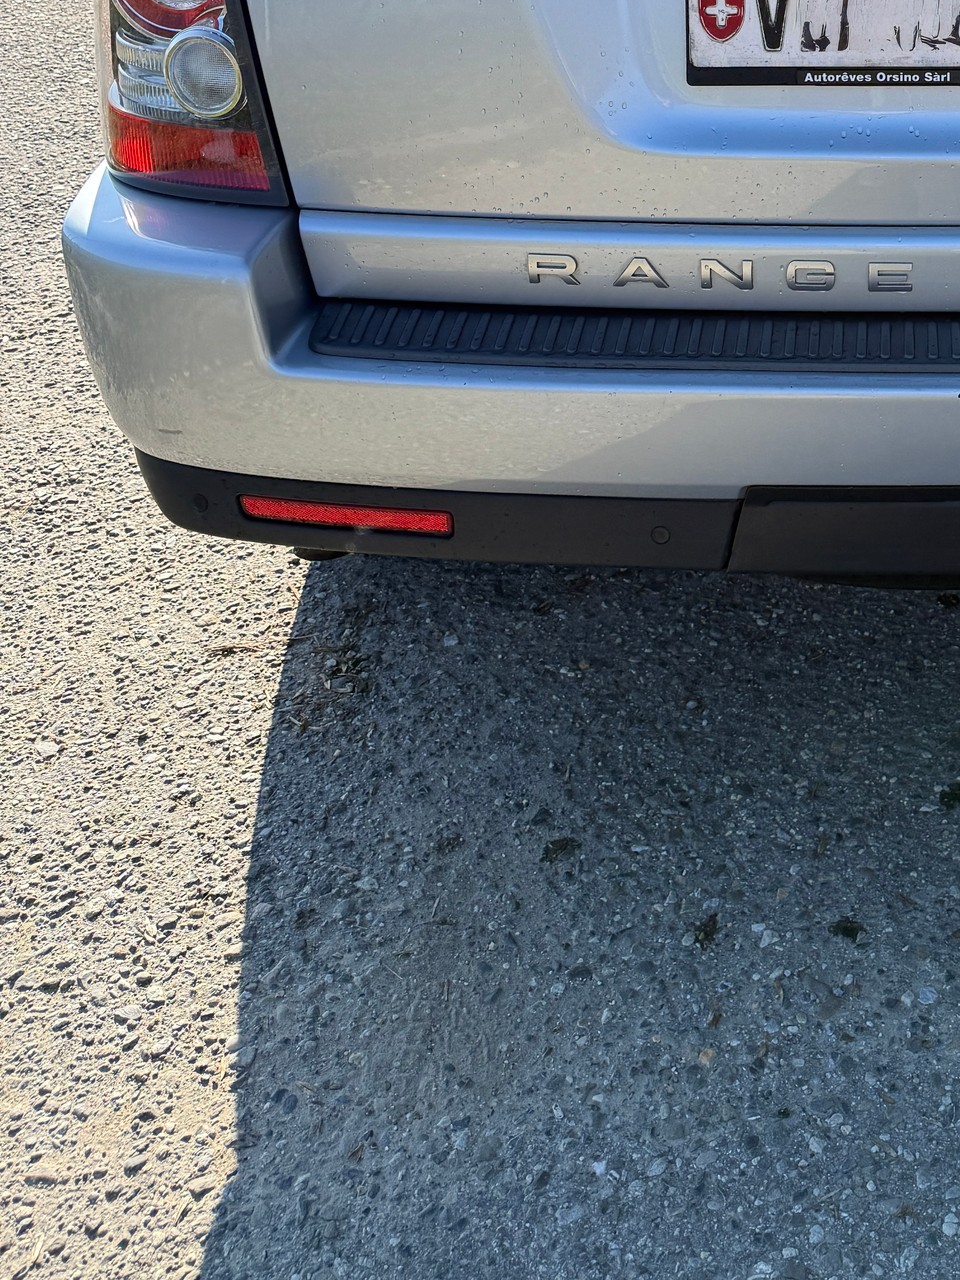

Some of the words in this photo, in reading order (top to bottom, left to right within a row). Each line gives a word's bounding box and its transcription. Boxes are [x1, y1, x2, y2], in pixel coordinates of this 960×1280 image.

[804, 71, 872, 83] Autorêves
[876, 71, 920, 82] Orsino
[527, 252, 913, 293] RANGE
